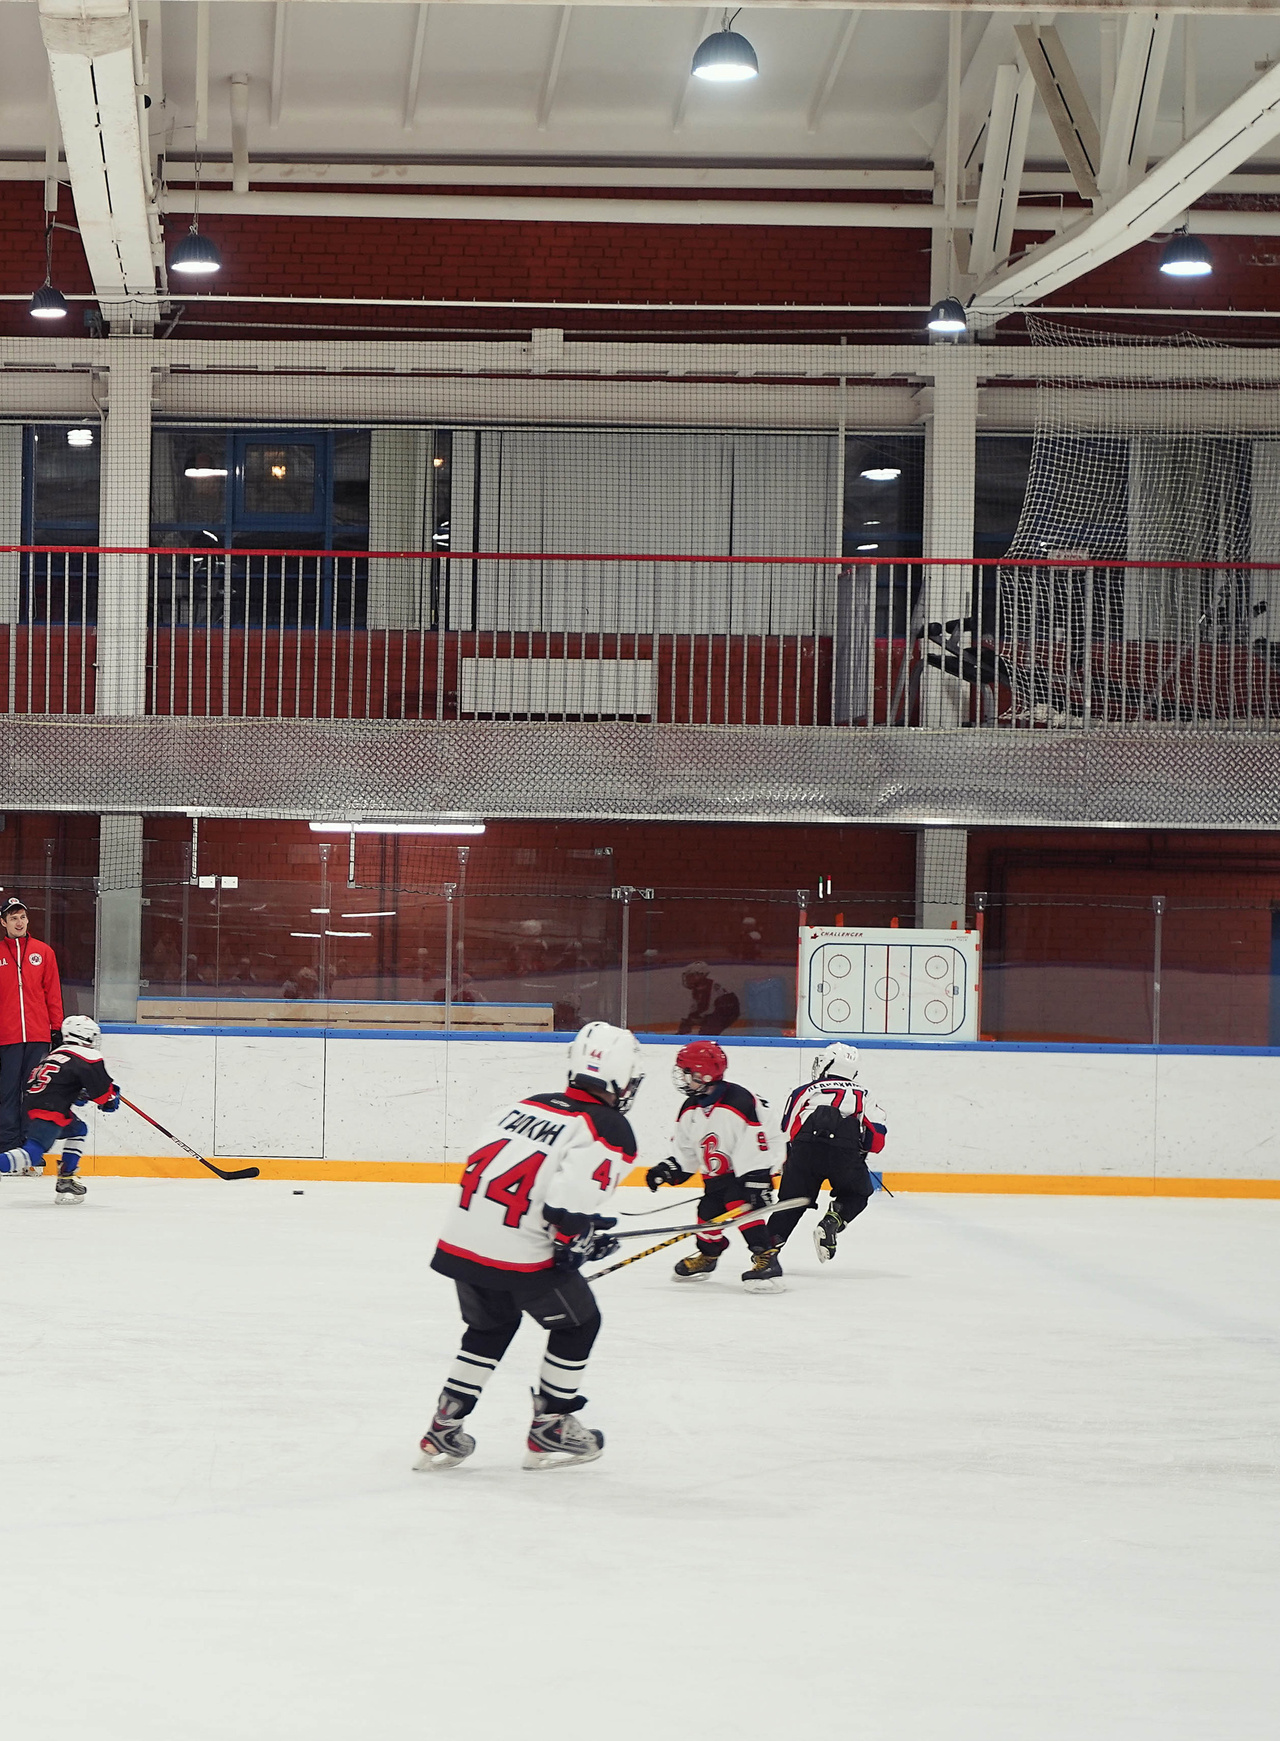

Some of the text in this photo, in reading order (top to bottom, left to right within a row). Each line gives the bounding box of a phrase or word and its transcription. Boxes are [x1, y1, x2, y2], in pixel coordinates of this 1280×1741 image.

[820, 1088, 864, 1116] 71
[459, 1137, 547, 1229] 44
[592, 1158, 619, 1192] 4
